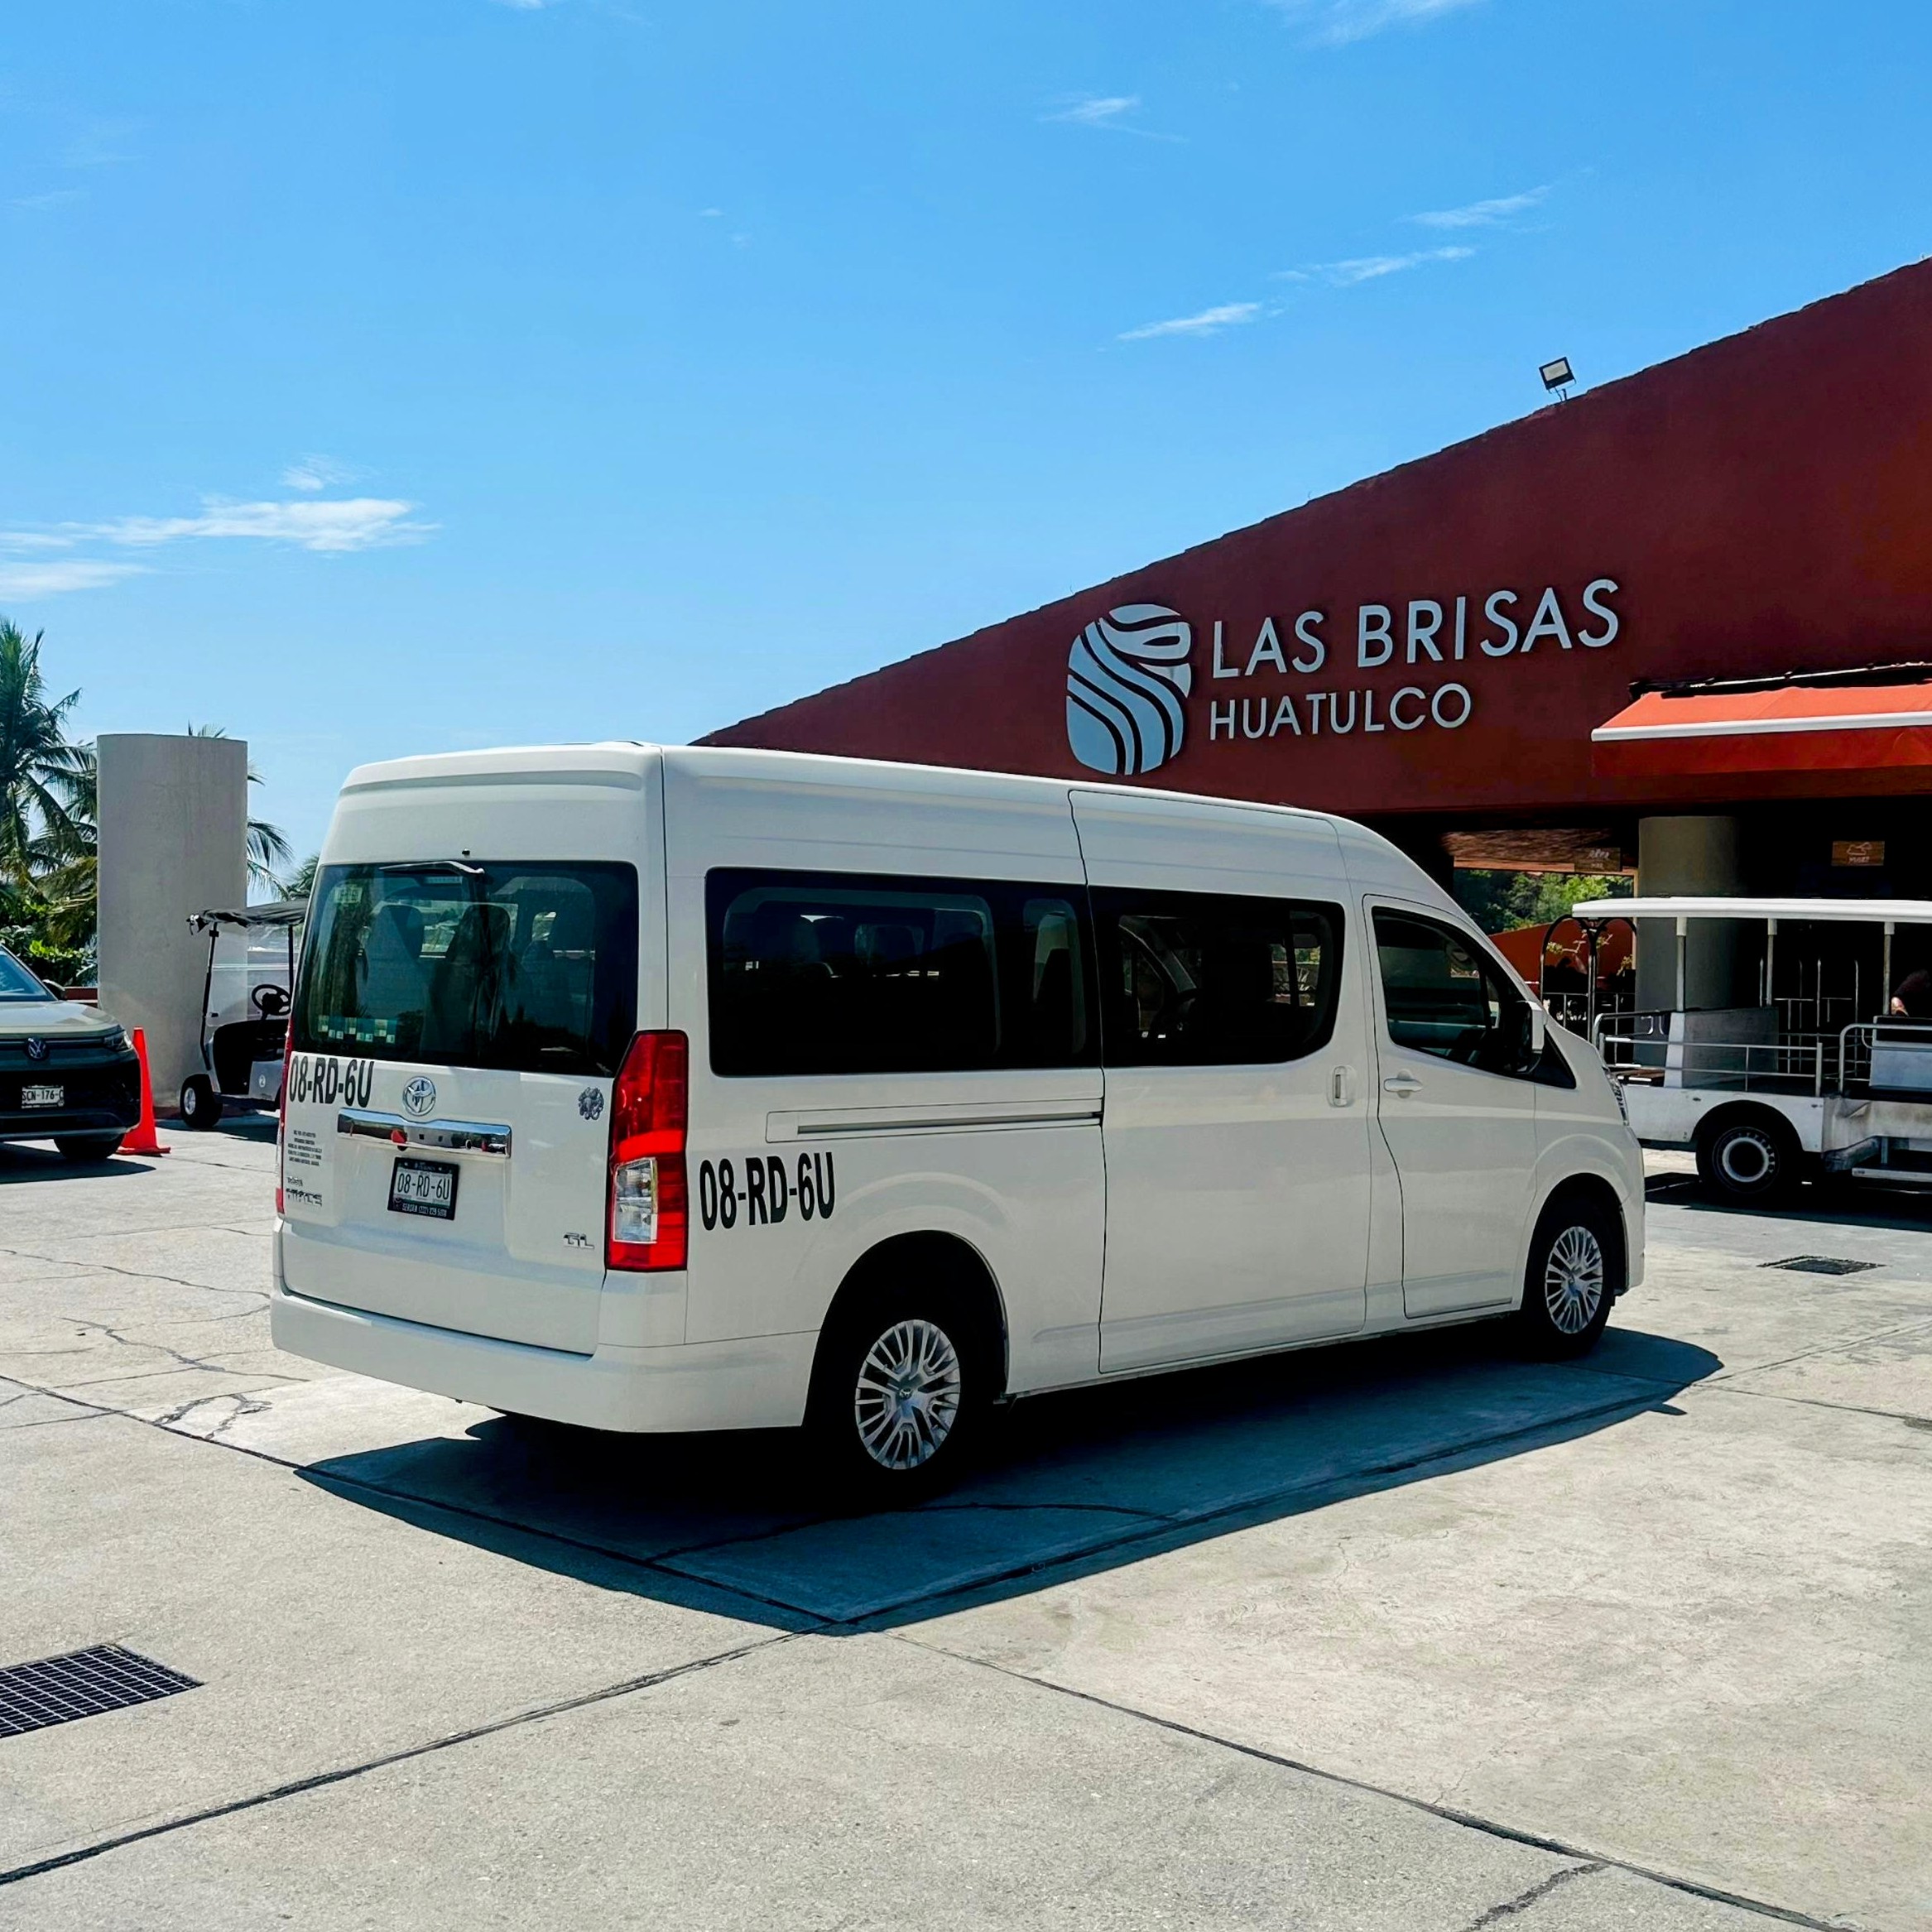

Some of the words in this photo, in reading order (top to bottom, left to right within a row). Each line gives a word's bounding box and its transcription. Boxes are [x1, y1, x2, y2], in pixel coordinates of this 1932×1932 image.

[1212, 611, 1325, 679] LAS
[1357, 579, 1619, 668] BRISAS
[1209, 683, 1472, 740] HUATULCO
[289, 1055, 375, 1108] 08-RD-6U
[397, 1173, 450, 1199] 08-RD-6U
[699, 1151, 835, 1231] 08-RD-6U
[563, 1232, 595, 1249] GL
